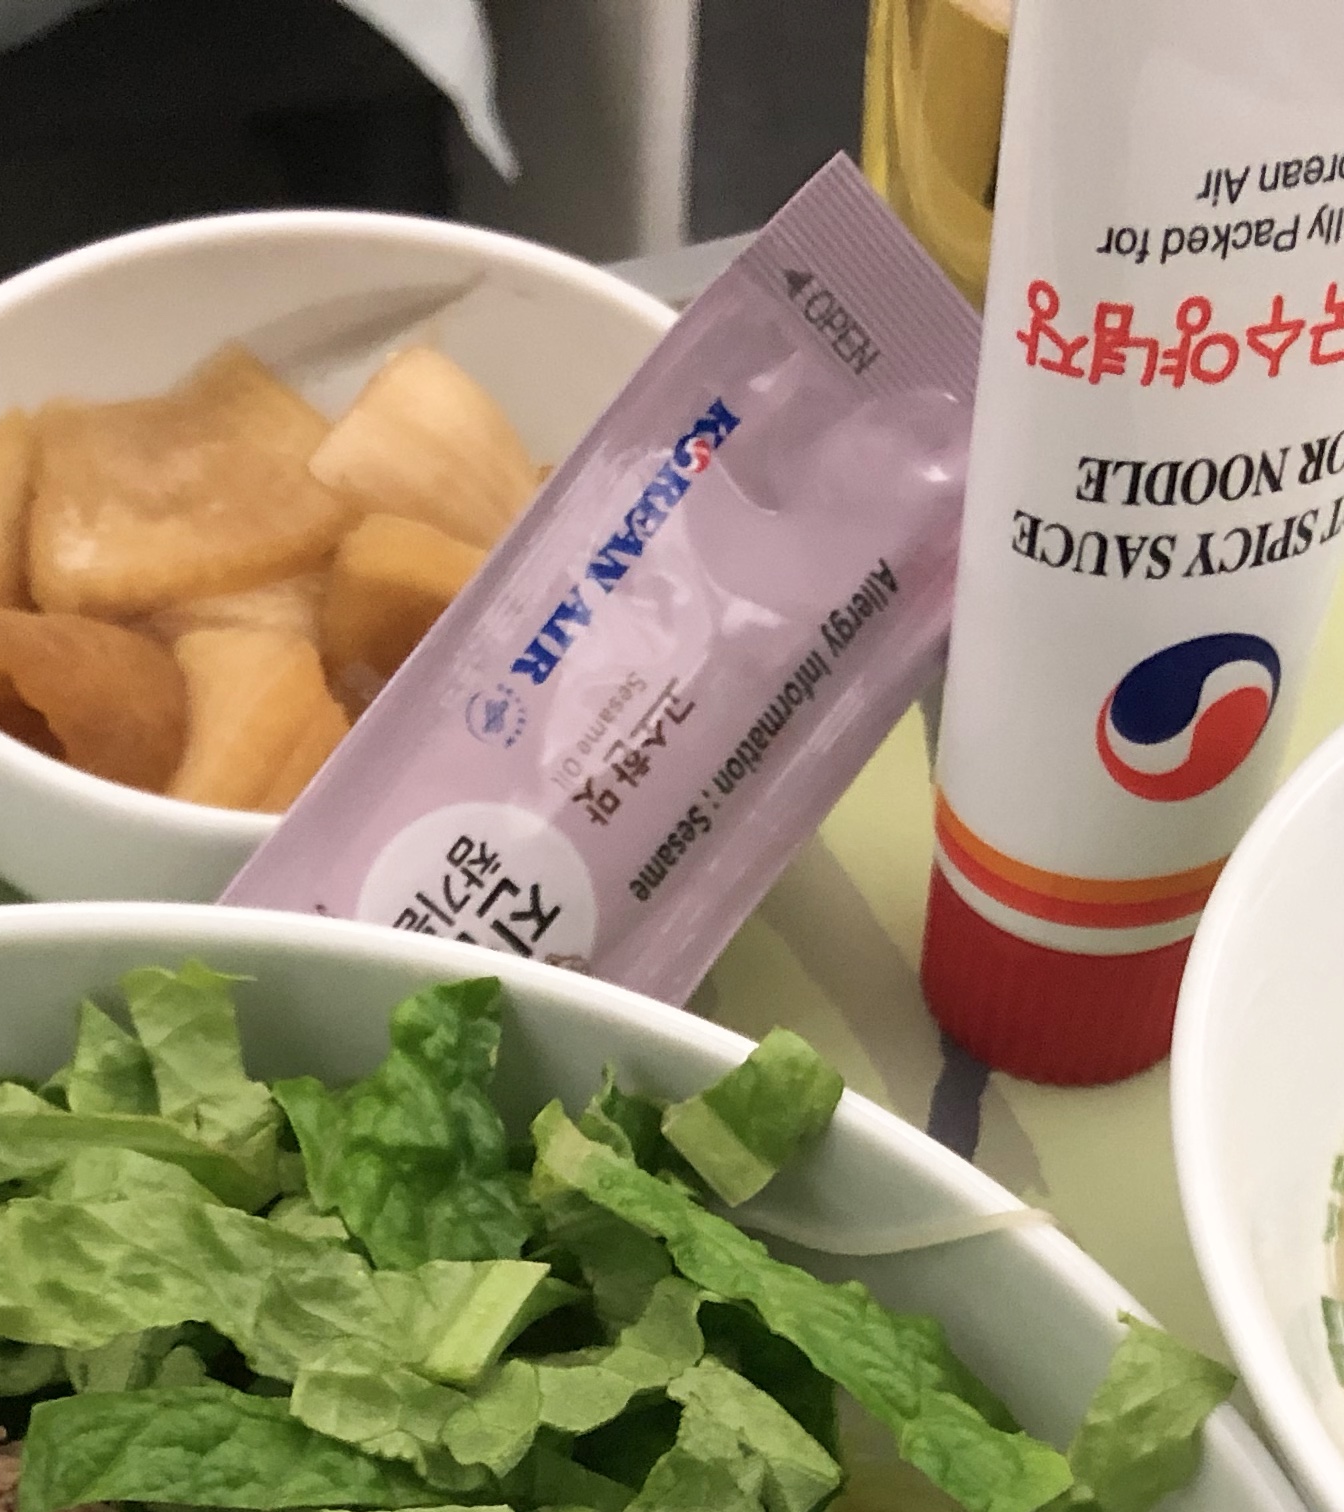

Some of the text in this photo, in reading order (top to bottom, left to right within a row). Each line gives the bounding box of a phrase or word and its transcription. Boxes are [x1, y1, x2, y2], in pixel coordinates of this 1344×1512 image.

[1196, 164, 1250, 206] Air
[1096, 226, 1150, 265] for
[1160, 213, 1301, 264] Packed
[801, 289, 882, 375] OPEN
[1075, 446, 1292, 506] NOODLE
[511, 396, 740, 686] KOREAN AIR
[1011, 509, 1178, 580] SAUCE
[1182, 507, 1319, 577] SPICY
[821, 557, 899, 658] Allergy
[550, 671, 648, 793] Sesame Oil
[572, 676, 696, 826] 고소한 맛
[712, 650, 832, 795] Information
[629, 804, 713, 902] Sesame
[455, 877, 561, 957] 진
